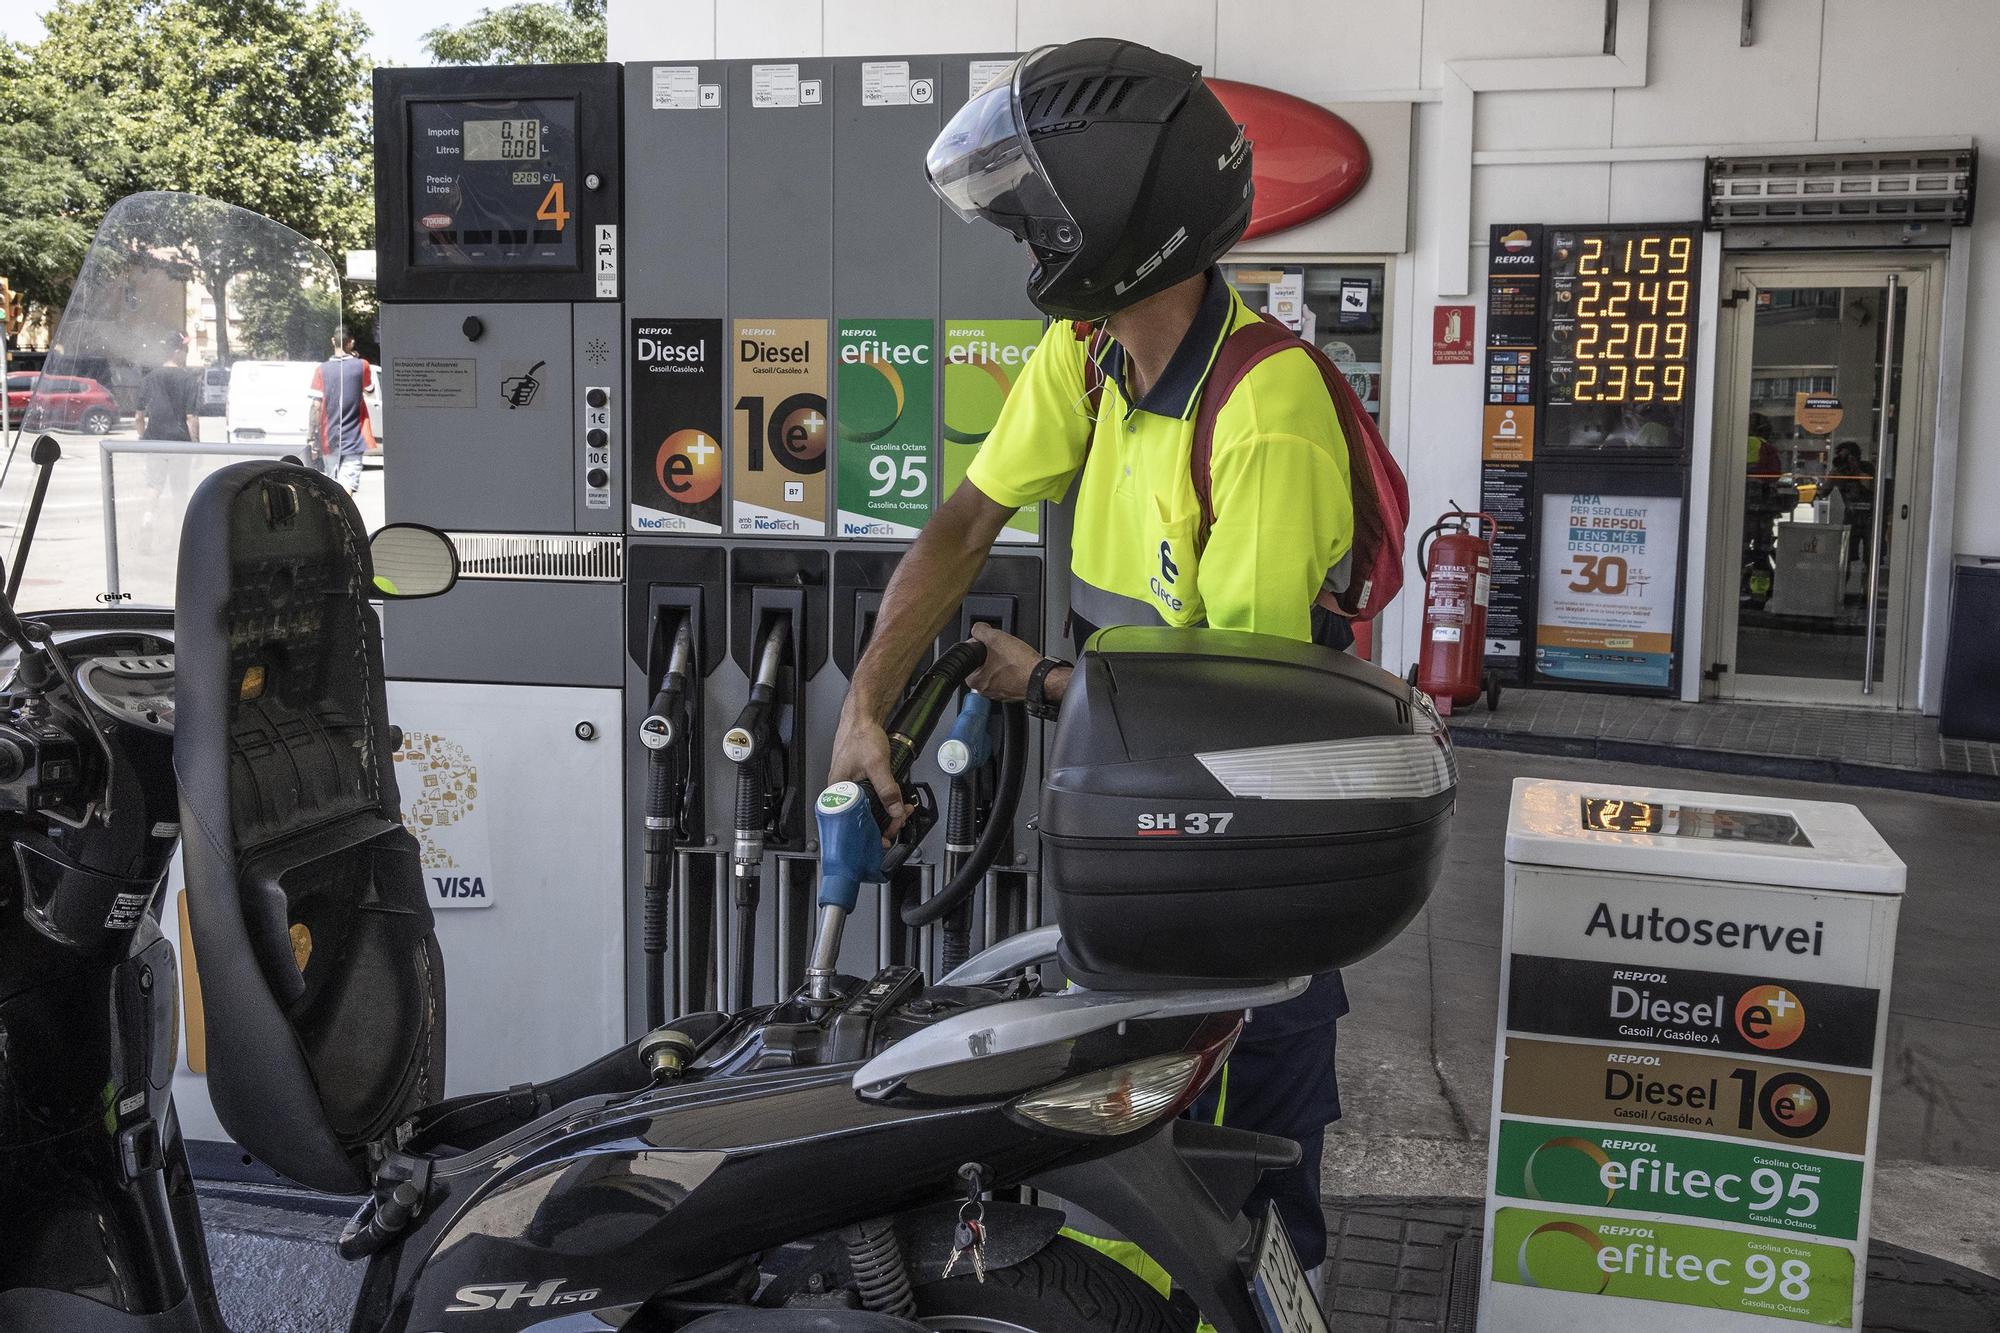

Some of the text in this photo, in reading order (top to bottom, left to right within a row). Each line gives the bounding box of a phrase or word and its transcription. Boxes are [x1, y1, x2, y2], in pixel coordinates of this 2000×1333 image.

[428, 128, 459, 137] Importe
[542, 126, 549, 134] €
[542, 144, 549, 152] L
[427, 175, 452, 183] Precio
[427, 185, 450, 193] Litros
[536, 182, 570, 231] 4
[1114, 226, 1189, 296] LS2
[1495, 256, 1535, 264] REPSOL
[1578, 238, 1691, 275] 2.159
[1577, 281, 1689, 317] 2.249
[949, 329, 985, 337] REPSOL
[1576, 323, 1687, 359] 2.209
[637, 338, 705, 362] Diesel
[741, 340, 809, 363] Diesel
[841, 341, 928, 365] efitec
[1574, 366, 1685, 401] 2.359
[870, 443, 927, 451] Gasolina Octans
[869, 455, 927, 498] 95
[789, 487, 799, 495] B7
[1572, 494, 1601, 505] ARA
[867, 501, 928, 510] Gasolina Octanos
[1571, 506, 1648, 517] PER SER CLIENT
[1570, 516, 1646, 530] DE REPSOL
[1577, 530, 1638, 543] TENS MÉS
[1568, 541, 1646, 555] DESCOMPTE
[1150, 577, 1183, 611] Clece
[1137, 813, 1234, 834] SH 37
[432, 877, 486, 898] VISA
[1584, 903, 1824, 956] Autoservei
[1612, 970, 1668, 984] REPSOL
[1609, 985, 1725, 1028] Diesel
[1618, 1024, 1654, 1038] Gasoil
[1663, 1028, 1708, 1043] Gasóleo
[1711, 1034, 1720, 1044] A
[1607, 1053, 1661, 1066] REPSOL
[1604, 1068, 1718, 1110] Diesel
[1613, 1107, 1650, 1121] Gasoil
[1657, 1112, 1702, 1126] Gasóleo
[1704, 1118, 1714, 1127] A
[1601, 1139, 1658, 1153] REPSOL
[1753, 1156, 1822, 1173] Gasolina Octans
[1600, 1159, 1742, 1202] efitec
[1748, 1167, 1820, 1217] 95
[1748, 1213, 1817, 1230] Gasolina Octanos
[1598, 1224, 1655, 1239] REPSOL
[1747, 1241, 1812, 1257] Gasolina Octans
[1597, 1243, 1732, 1286] efitec
[1743, 1254, 1811, 1301] 98
[445, 1278, 601, 1312] SH 150
[1741, 1299, 1810, 1315] Gasolina Octanos
